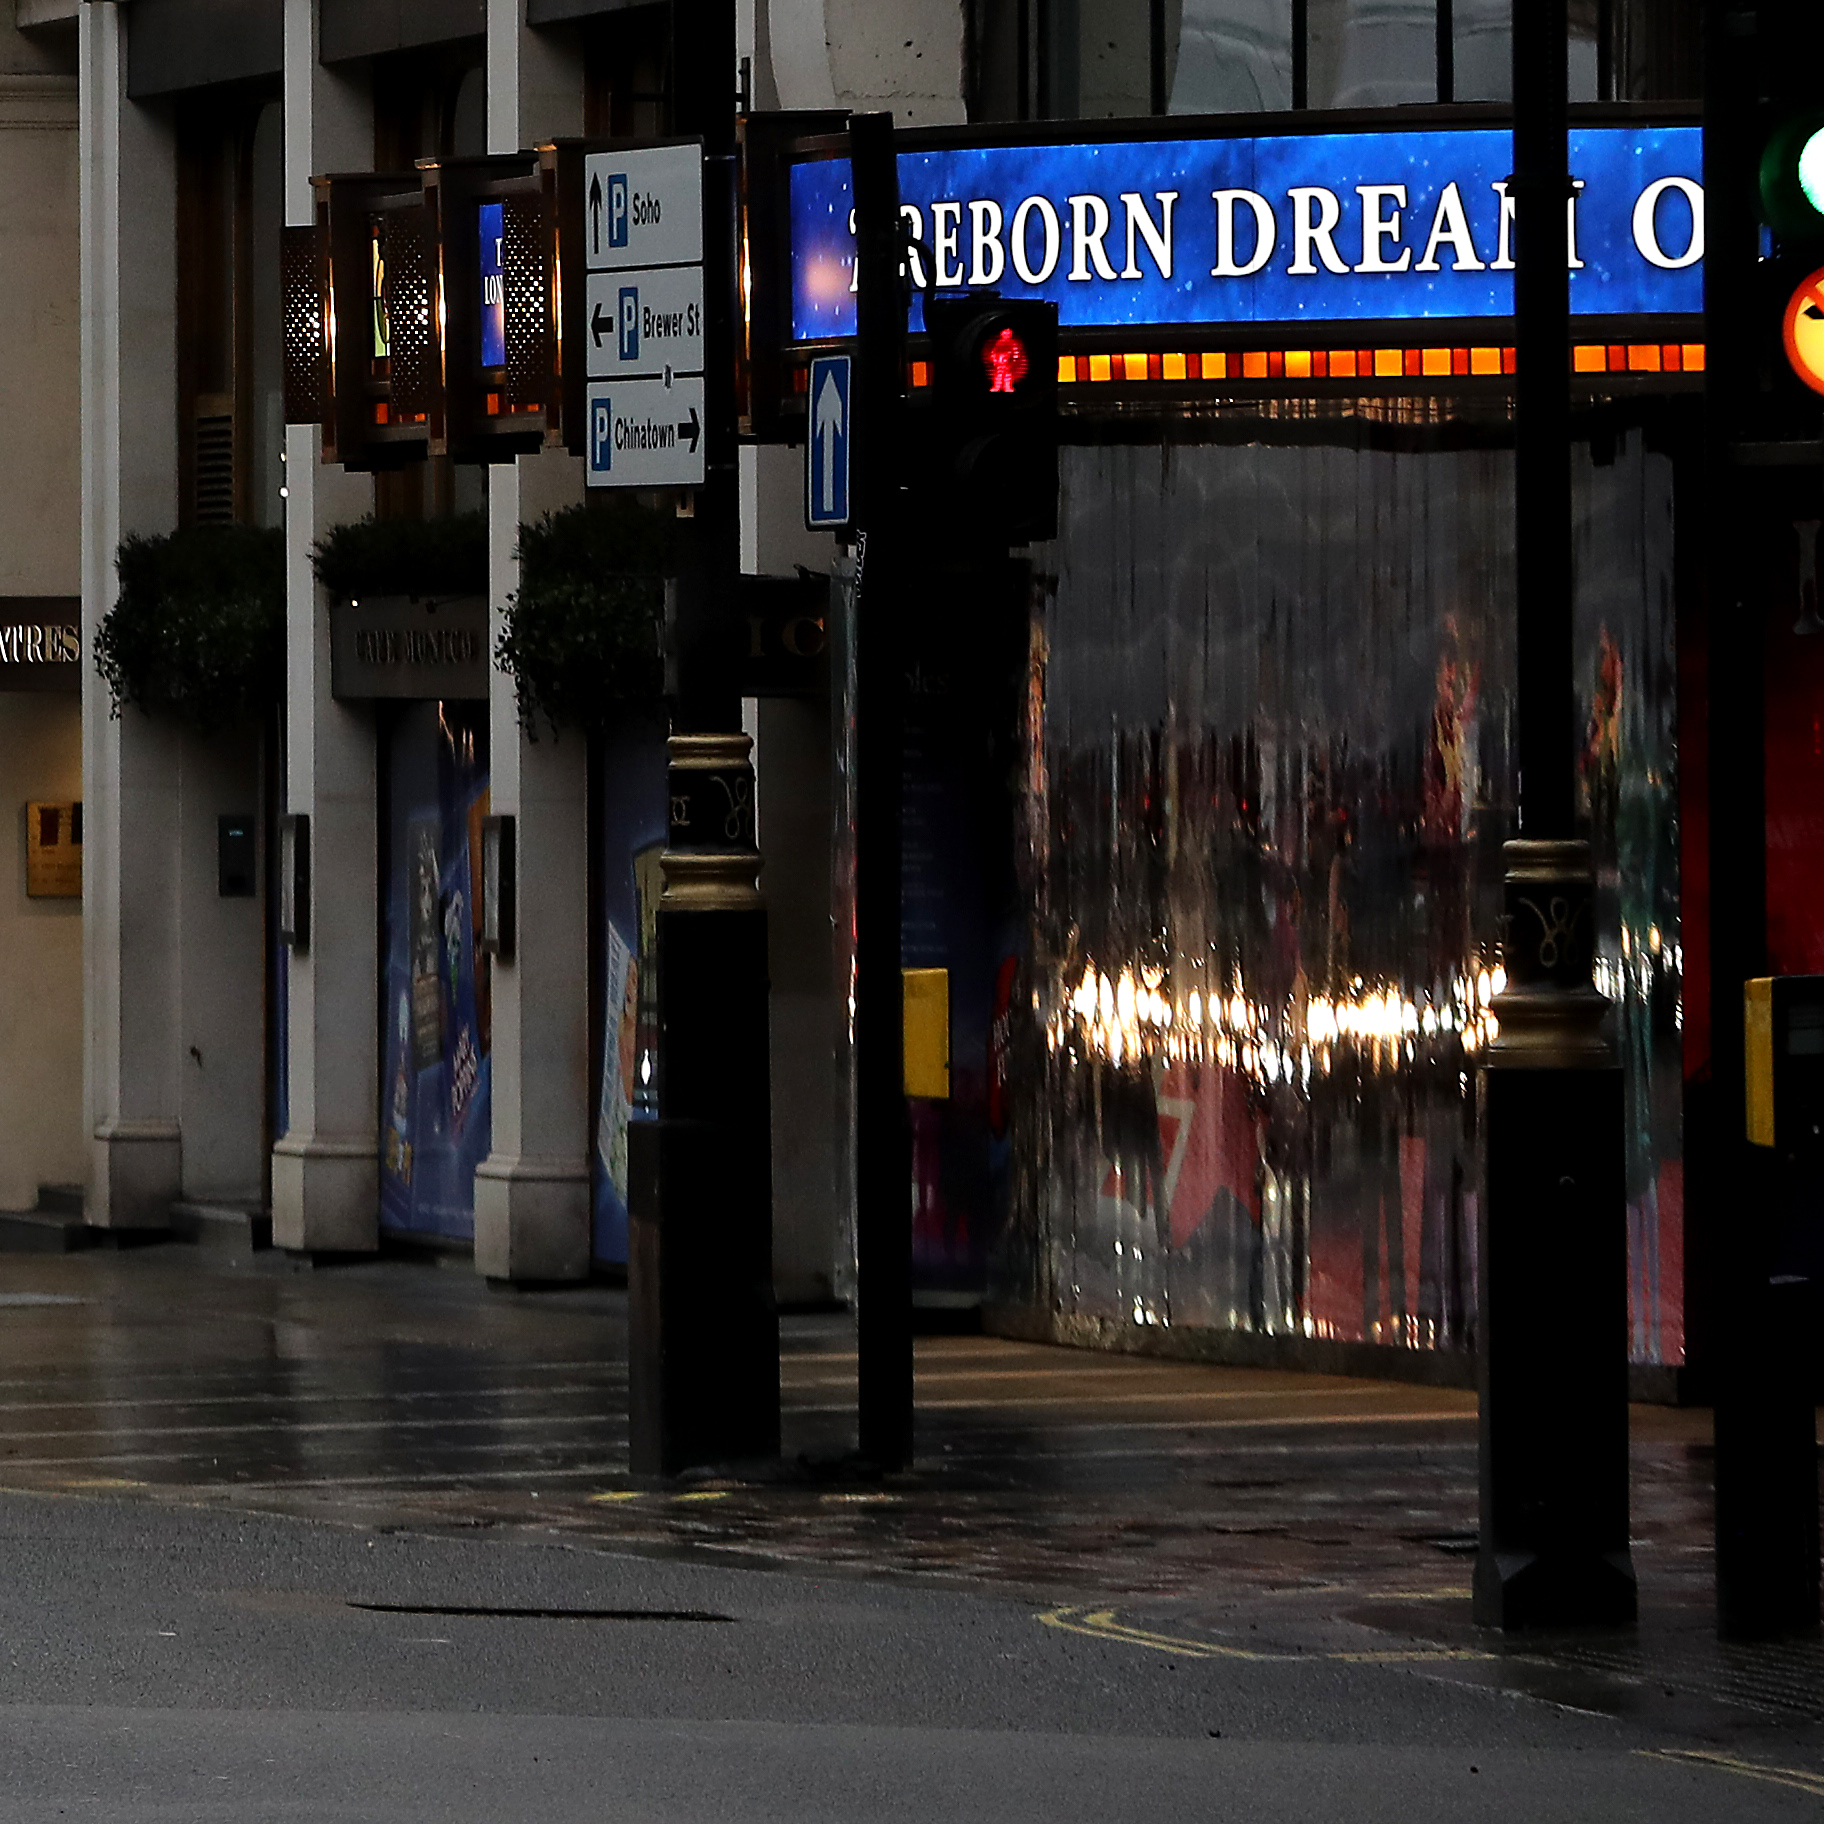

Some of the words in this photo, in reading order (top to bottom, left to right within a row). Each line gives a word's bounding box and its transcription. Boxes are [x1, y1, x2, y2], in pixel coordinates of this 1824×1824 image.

[632, 191, 661, 225] Soho
[1632, 176, 1704, 270] O
[643, 307, 683, 339] Brewer
[687, 303, 700, 337] St
[614, 417, 675, 451] Chinatown
